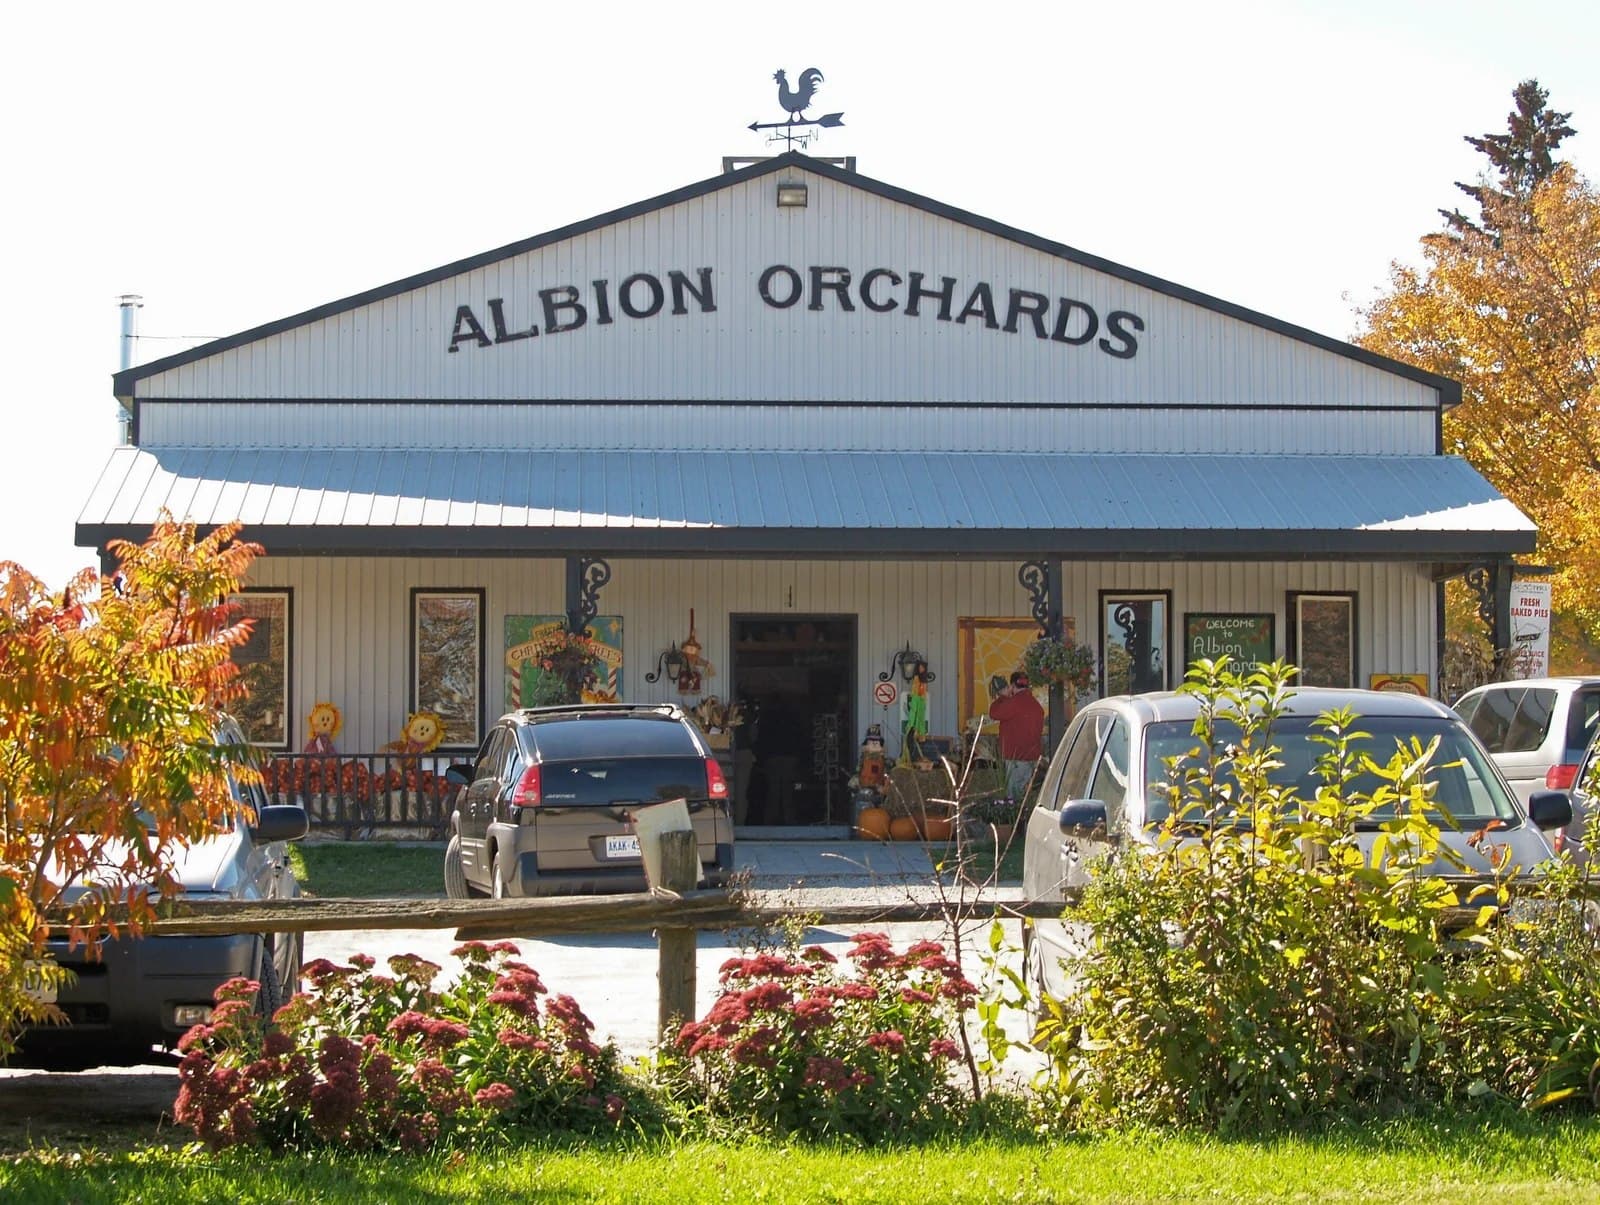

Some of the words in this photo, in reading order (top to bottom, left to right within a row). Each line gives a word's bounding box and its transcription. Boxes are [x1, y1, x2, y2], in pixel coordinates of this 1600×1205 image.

[447, 267, 718, 353] ALBION
[758, 264, 1145, 359] ORCHARDS
[1520, 597, 1541, 607] FRESH
[1511, 607, 1532, 617] BAKED
[1534, 609, 1549, 618] PIES
[1206, 619, 1255, 629] WELCOME
[1223, 629, 1233, 638] to
[1193, 635, 1245, 658] Albion
